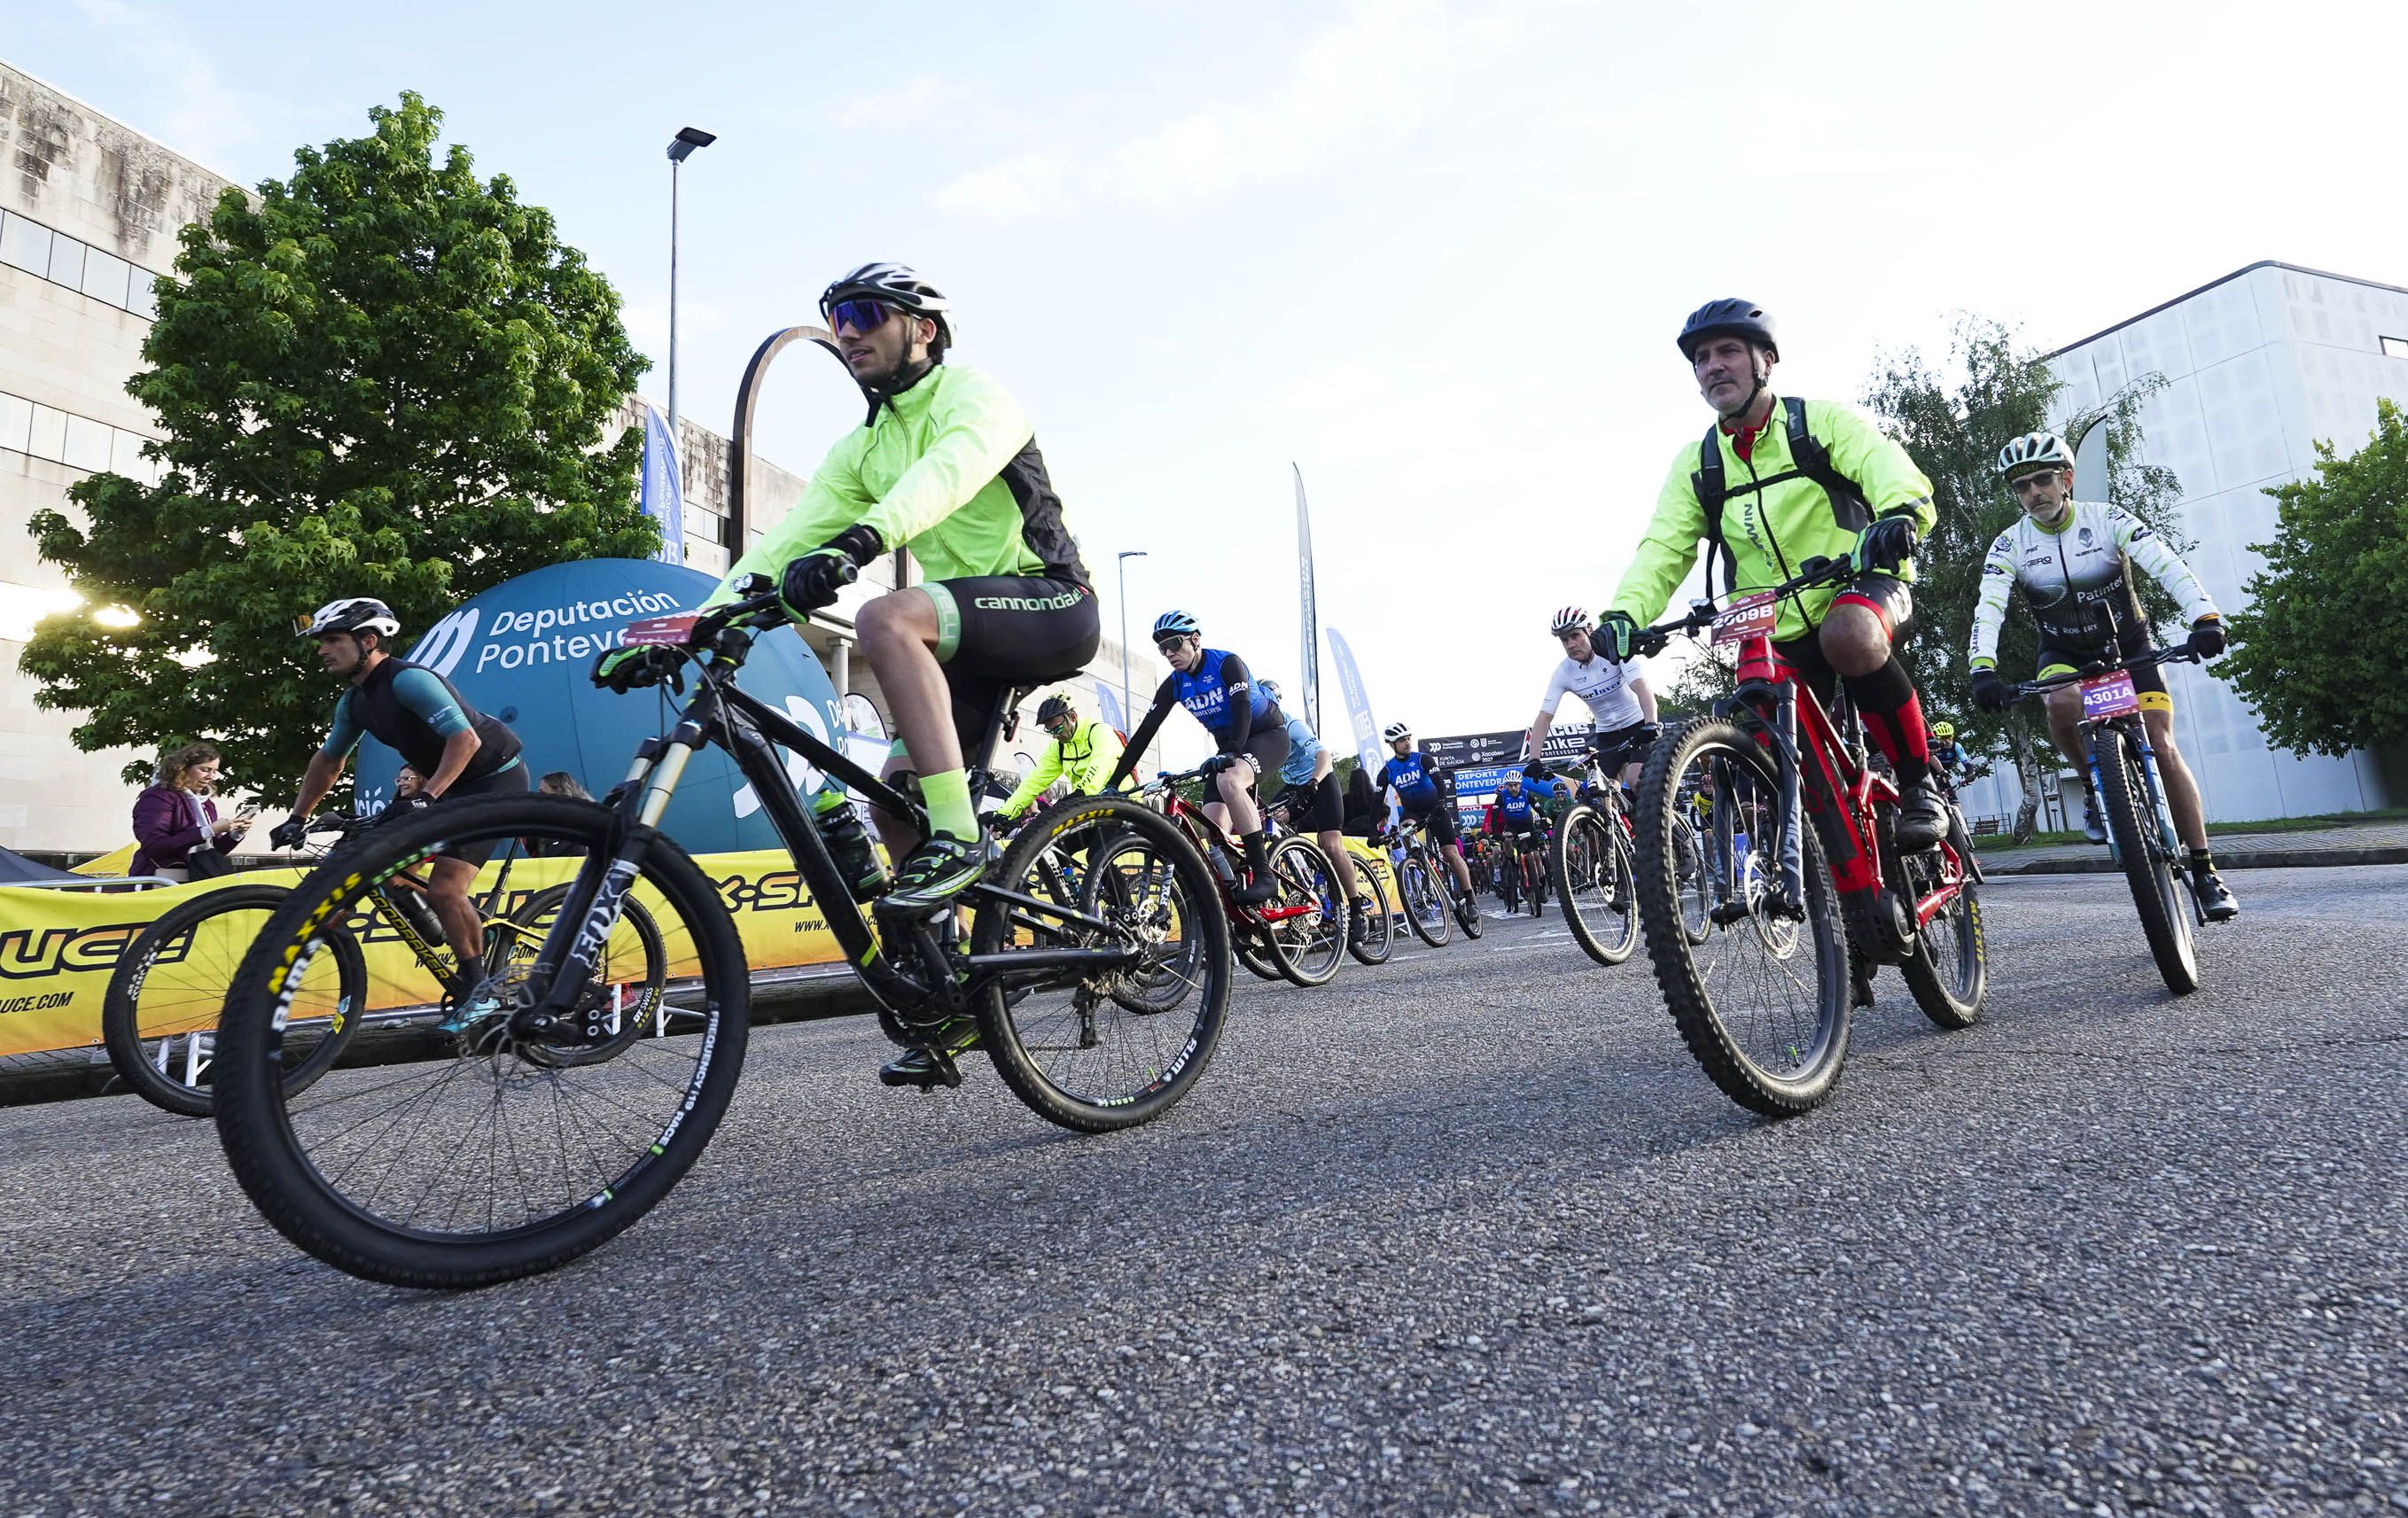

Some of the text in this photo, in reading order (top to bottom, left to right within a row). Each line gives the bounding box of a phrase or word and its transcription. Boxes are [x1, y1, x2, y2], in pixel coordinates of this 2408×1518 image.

[974, 588, 1083, 611] cannonda
[2077, 575, 2124, 603] Patinter
[488, 588, 681, 638] Deputación
[1185, 687, 1224, 712] ADN
[2083, 686, 2135, 706] 4301A
[1395, 769, 1421, 786] ADN
[1455, 777, 1505, 790] ONTEVEDRA
[1458, 770, 1498, 781] DEPORTE
[1051, 808, 1115, 837] MAXXIS
[0, 991, 74, 1014] UCE.COM
[633, 987, 654, 1023] DT SWISS
[695, 1010, 721, 1089] FREQUENCY
[658, 1110, 685, 1147] RACE
